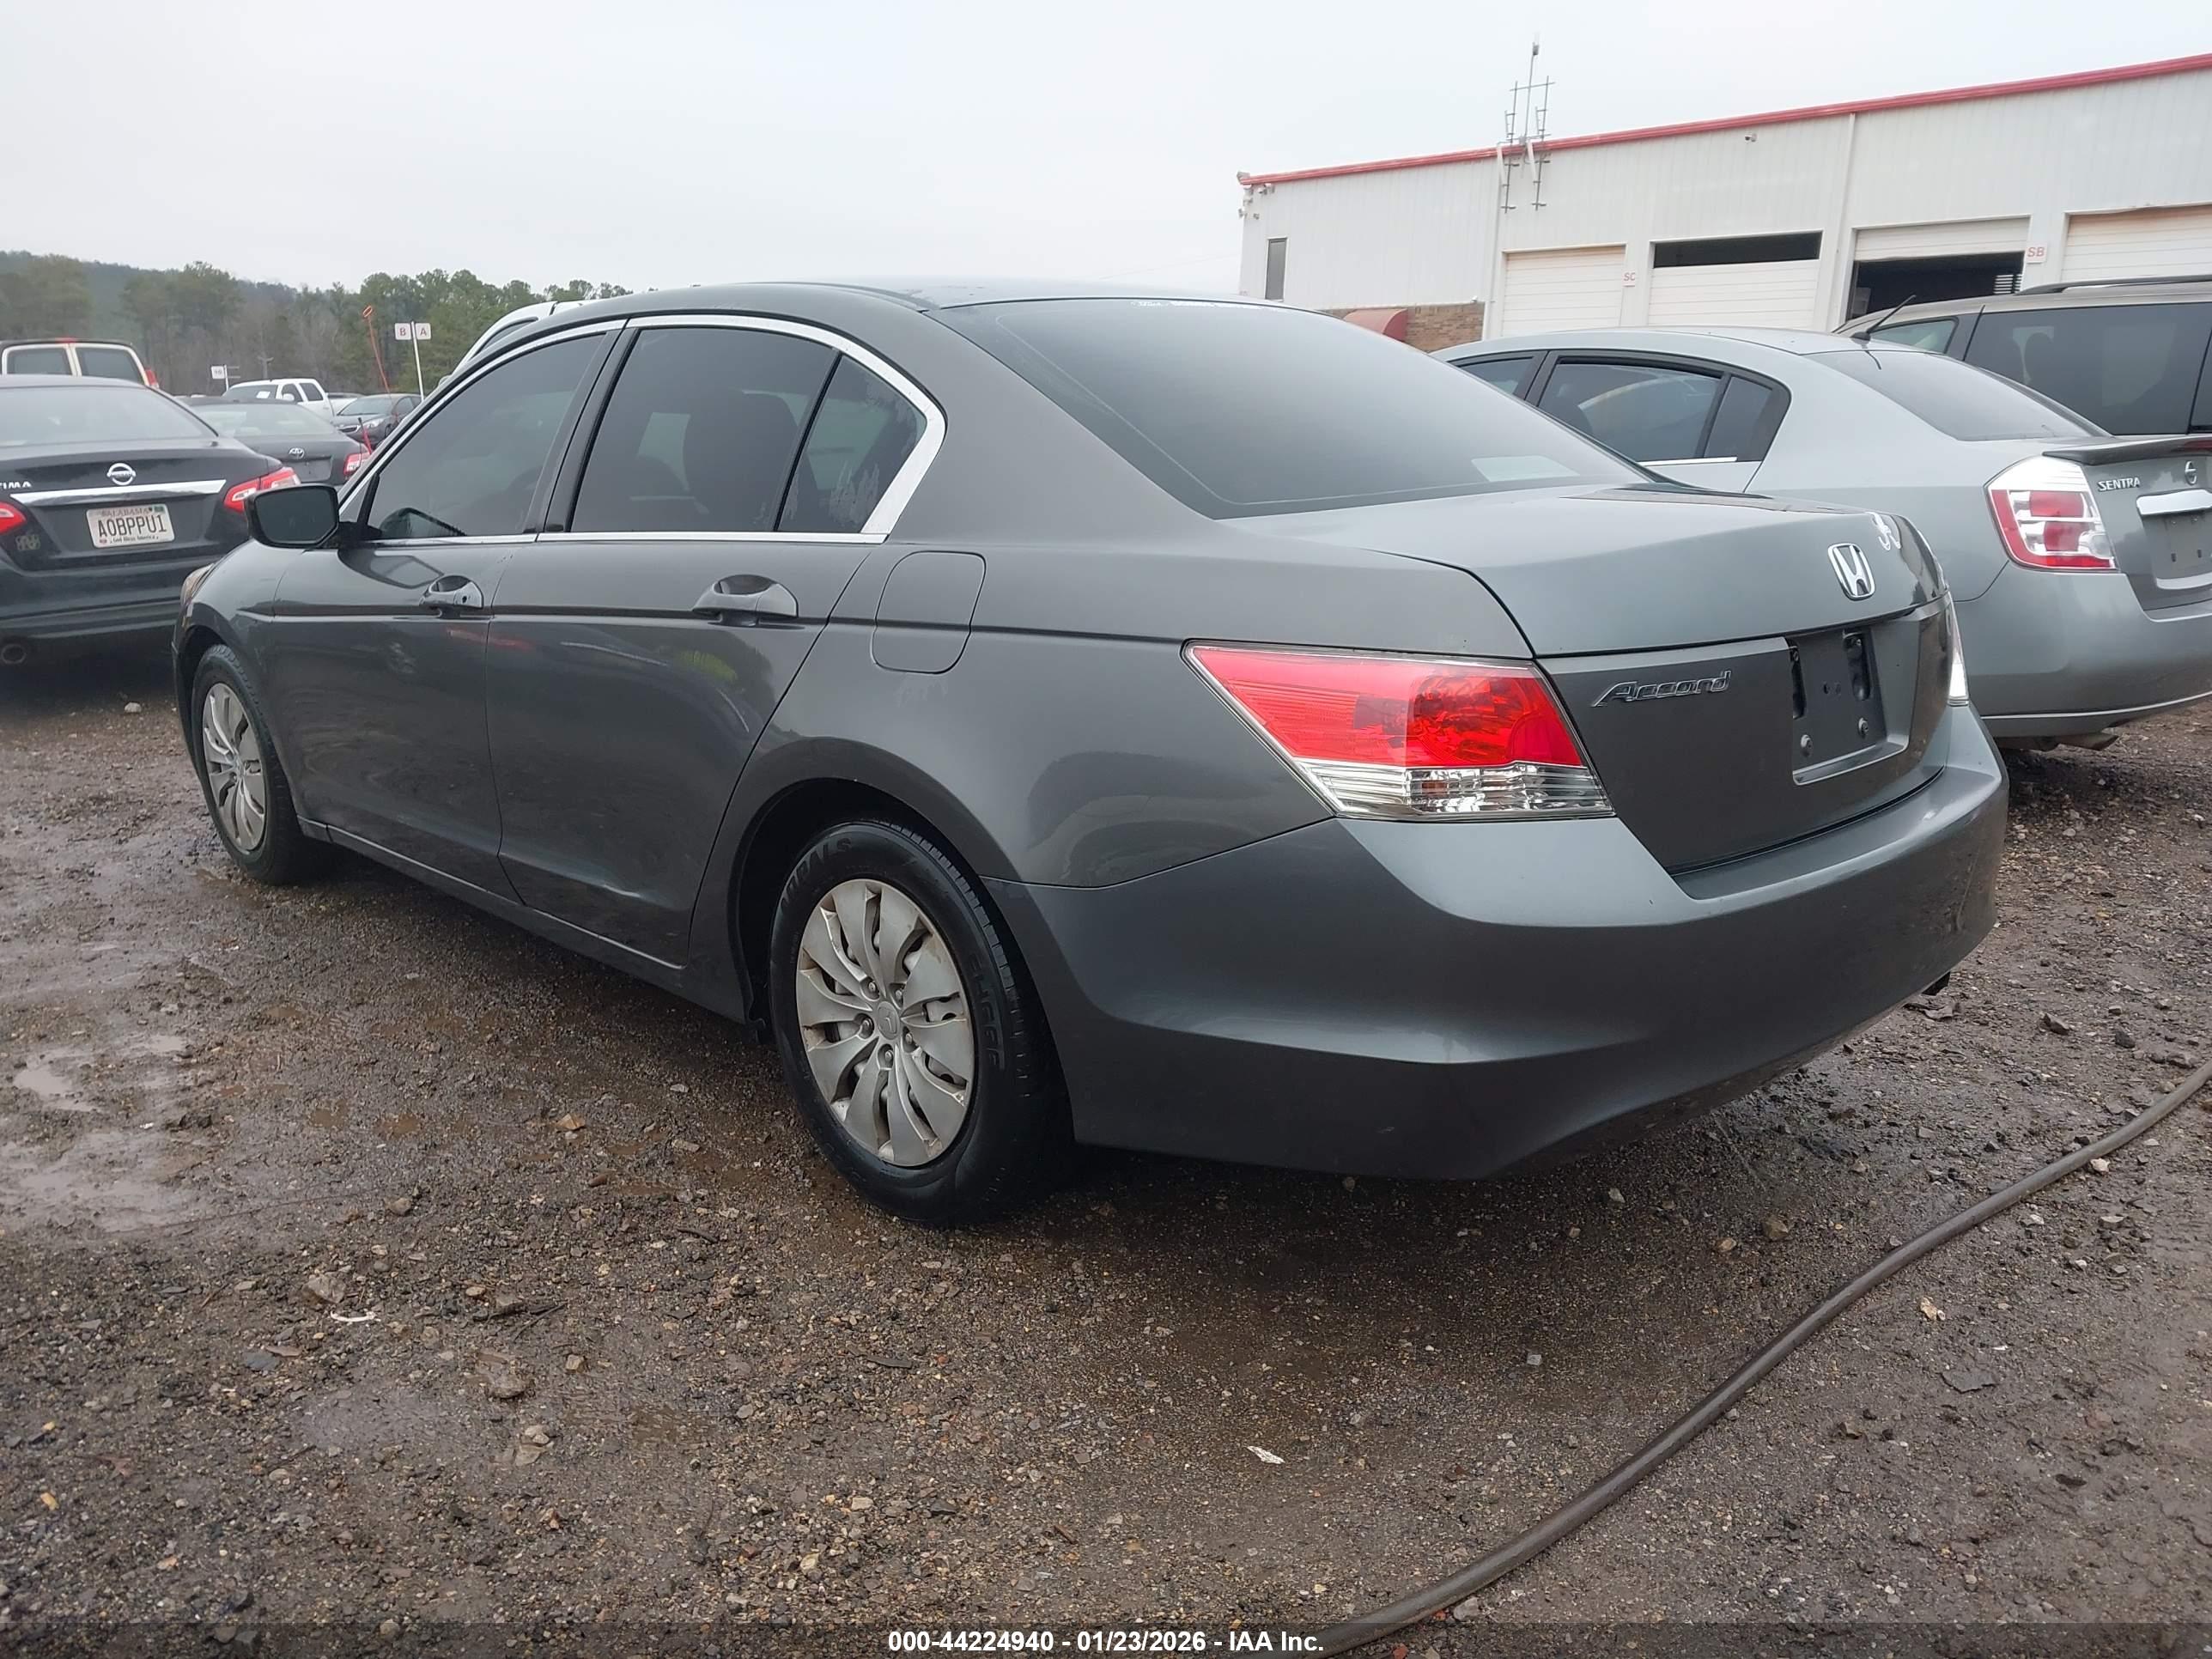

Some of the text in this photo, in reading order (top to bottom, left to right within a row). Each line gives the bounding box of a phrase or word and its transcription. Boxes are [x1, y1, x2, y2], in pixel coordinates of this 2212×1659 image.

[2027, 246, 2045, 257] SB
[400, 327, 406, 336] B
[420, 327, 427, 336] A
[2097, 477, 2140, 491] SENTRA
[1591, 670, 1731, 708] Accord
